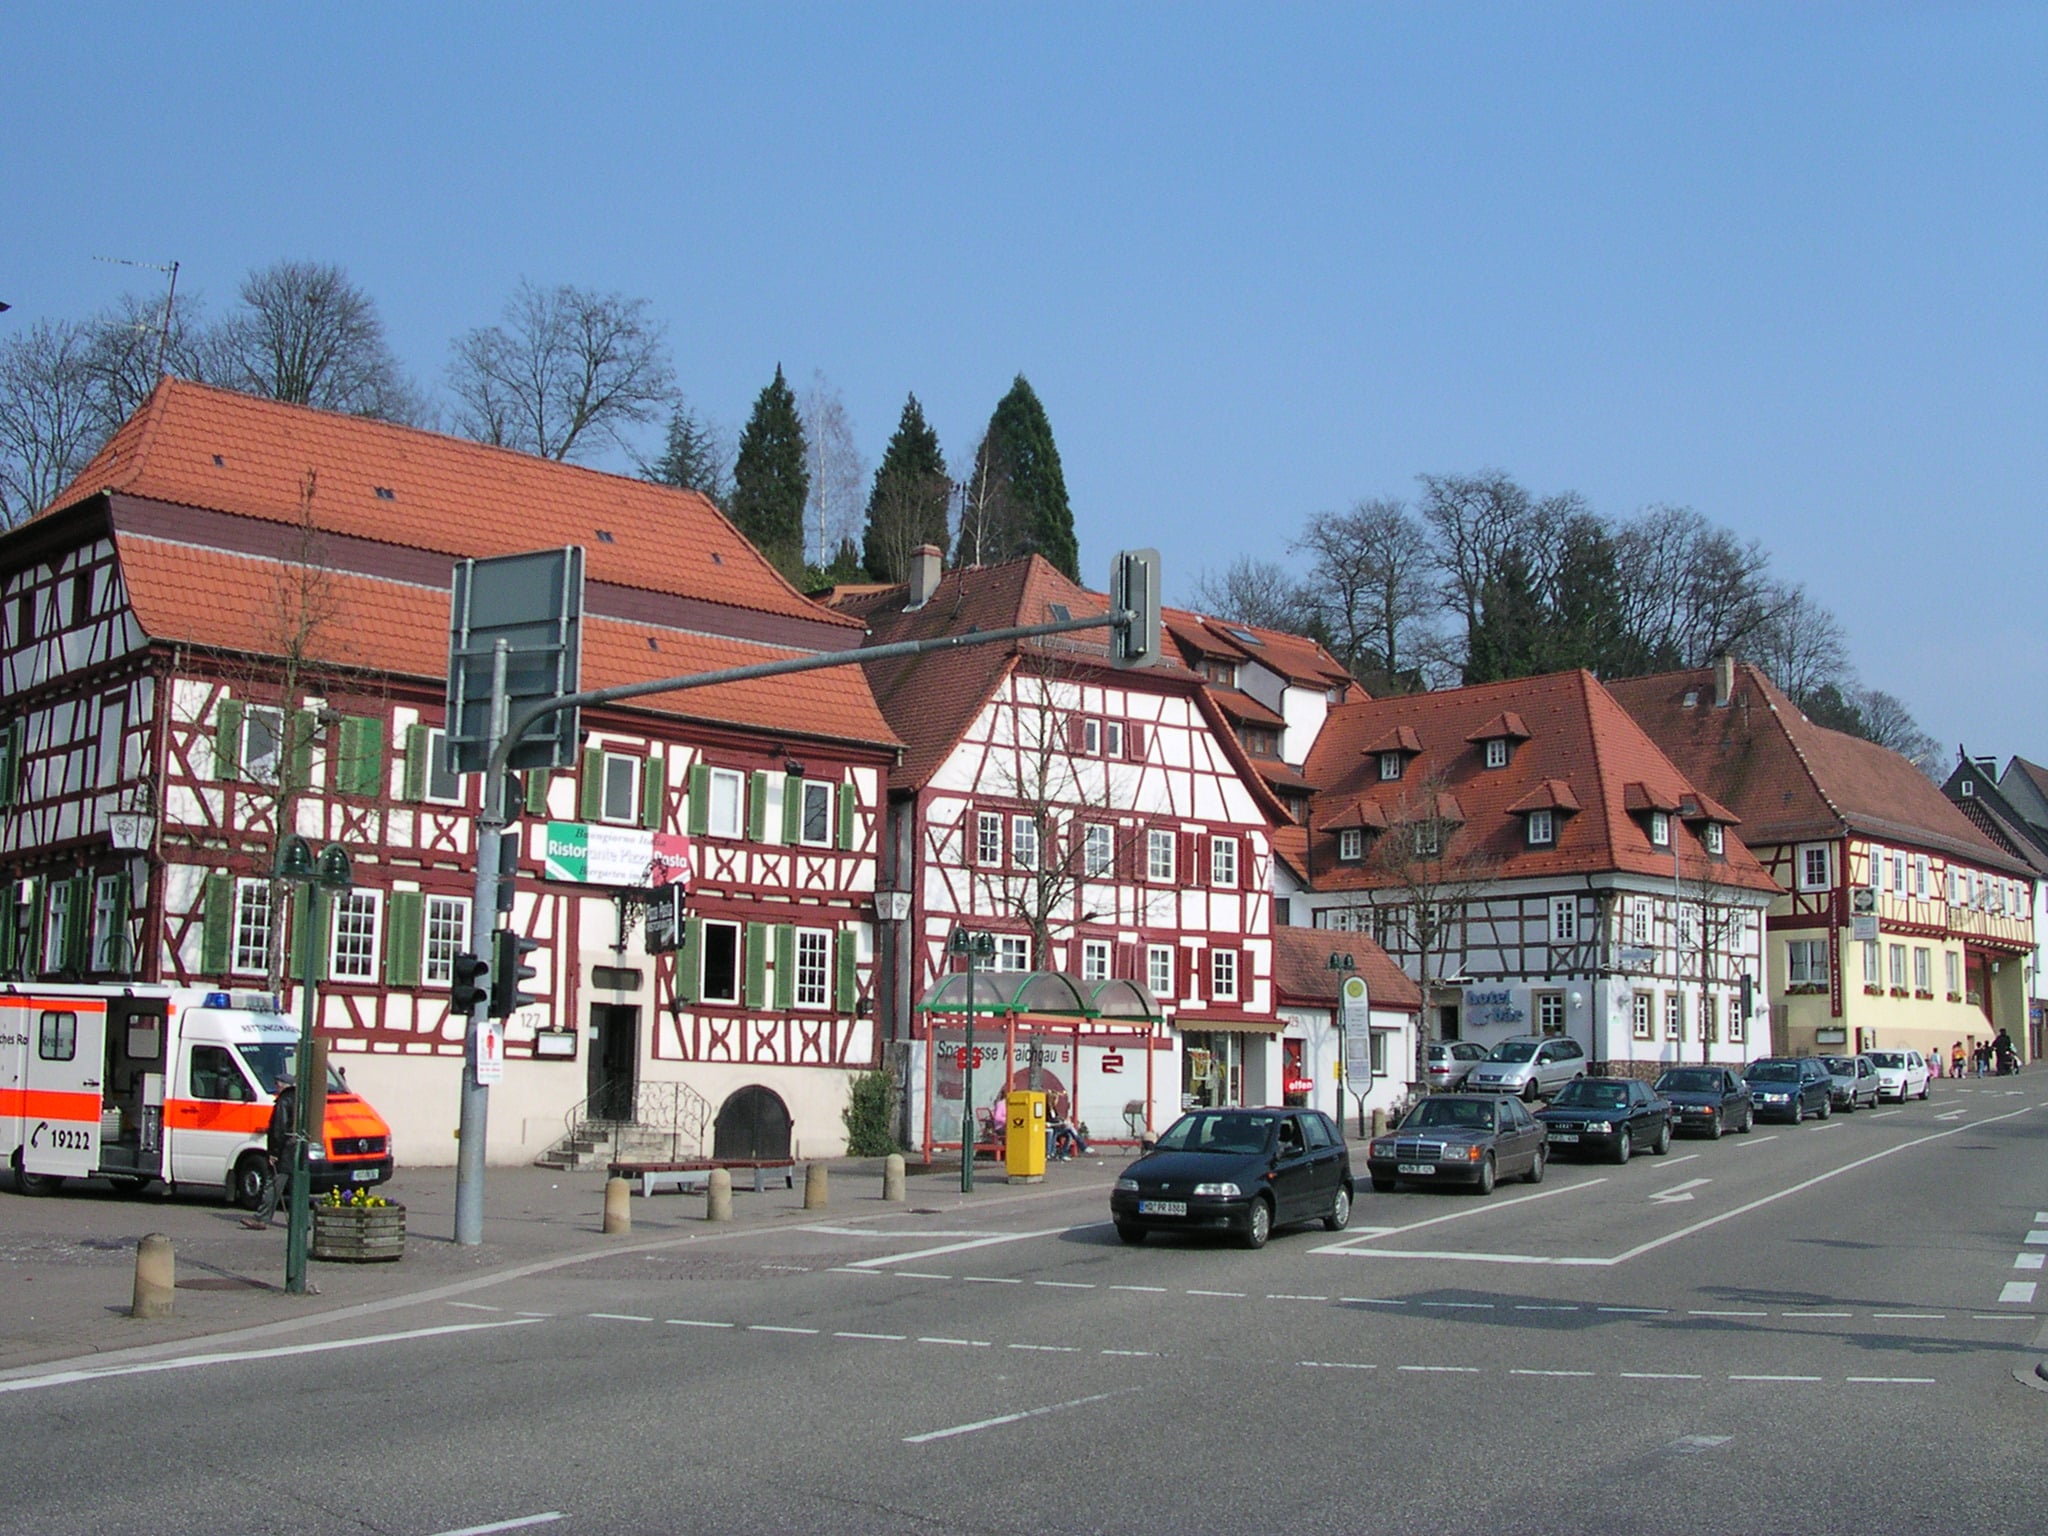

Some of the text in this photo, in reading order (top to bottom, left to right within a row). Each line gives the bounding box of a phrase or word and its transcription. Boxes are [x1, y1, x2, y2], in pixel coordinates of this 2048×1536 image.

[654, 850, 687, 868] Pasta
[521, 1012, 541, 1028] 127
[52, 1129, 90, 1150] 19222
